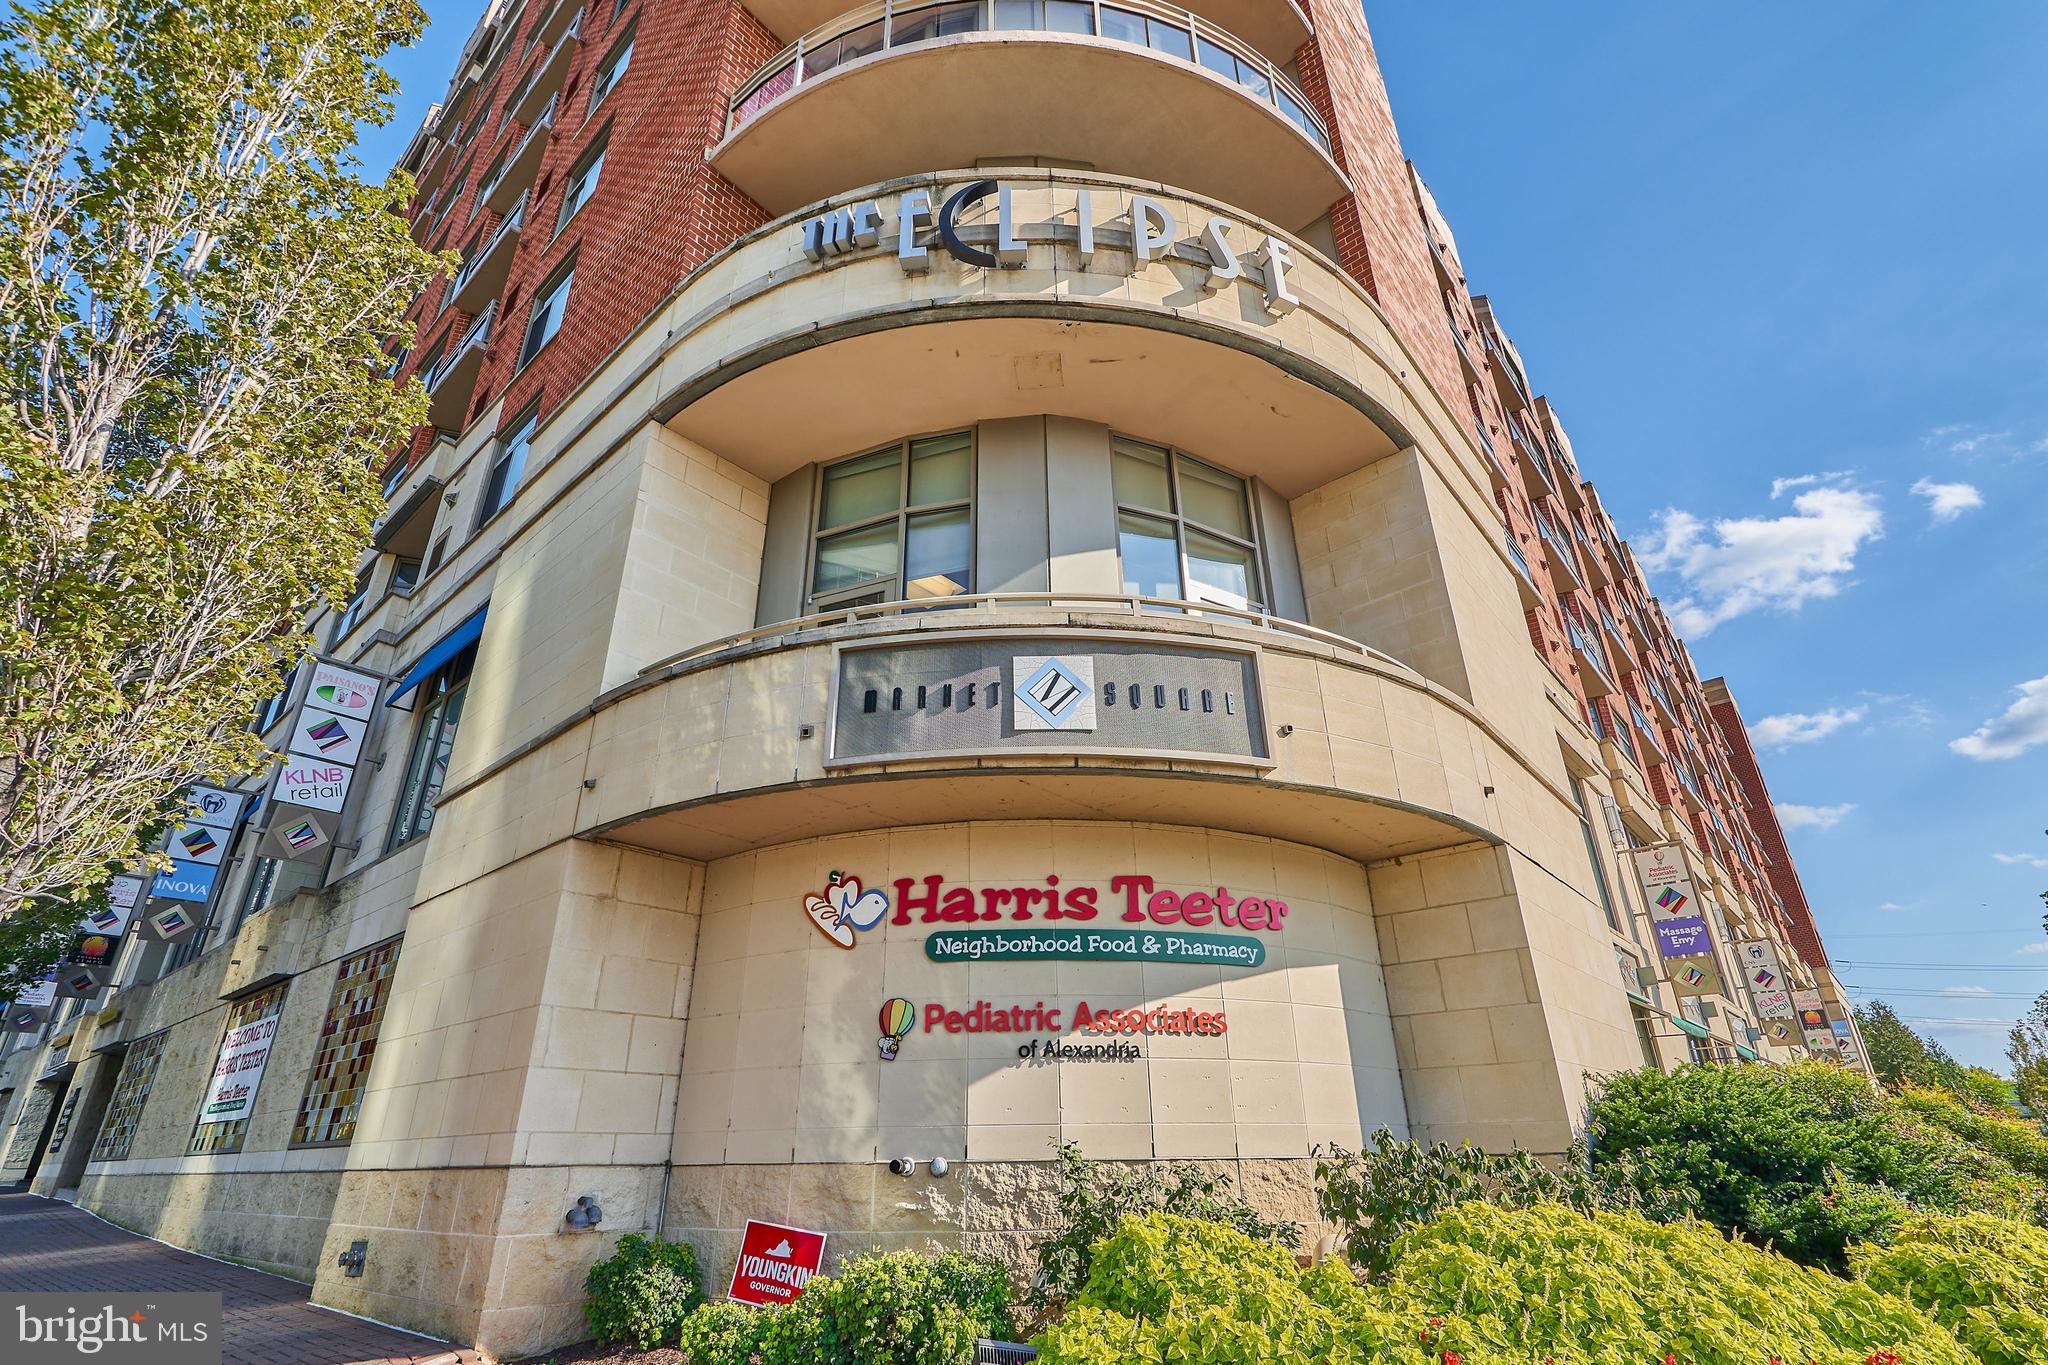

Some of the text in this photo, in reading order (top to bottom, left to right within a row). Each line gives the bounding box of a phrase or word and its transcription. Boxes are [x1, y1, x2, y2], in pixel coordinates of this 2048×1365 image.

[802, 180, 1299, 316] THE ECLIPSE
[864, 682, 1000, 714] MARKET
[1104, 682, 1235, 715] SQUARE
[285, 767, 343, 785] KLNB
[290, 783, 343, 800] retail
[1648, 868, 1678, 878] Associates
[1649, 865, 1675, 873] Pediatric
[156, 878, 207, 896] INOVA
[892, 874, 1289, 932] Harris Teeter
[1659, 925, 1703, 938] Massage
[935, 933, 1259, 965] Neighborhood Food & Pharmacy
[1671, 936, 1695, 947] Envy
[1757, 993, 1786, 1009] KLNB
[1765, 1001, 1791, 1016] retail
[923, 1001, 1229, 1037] Pediatric Associates
[225, 1020, 276, 1050] WELCOME TO
[1018, 1039, 1142, 1060] of Alexandria
[216, 1048, 267, 1078] HARRIS TEETER
[741, 1254, 814, 1290] YOUNGKIN
[749, 1281, 792, 1298] GOVERNOR
